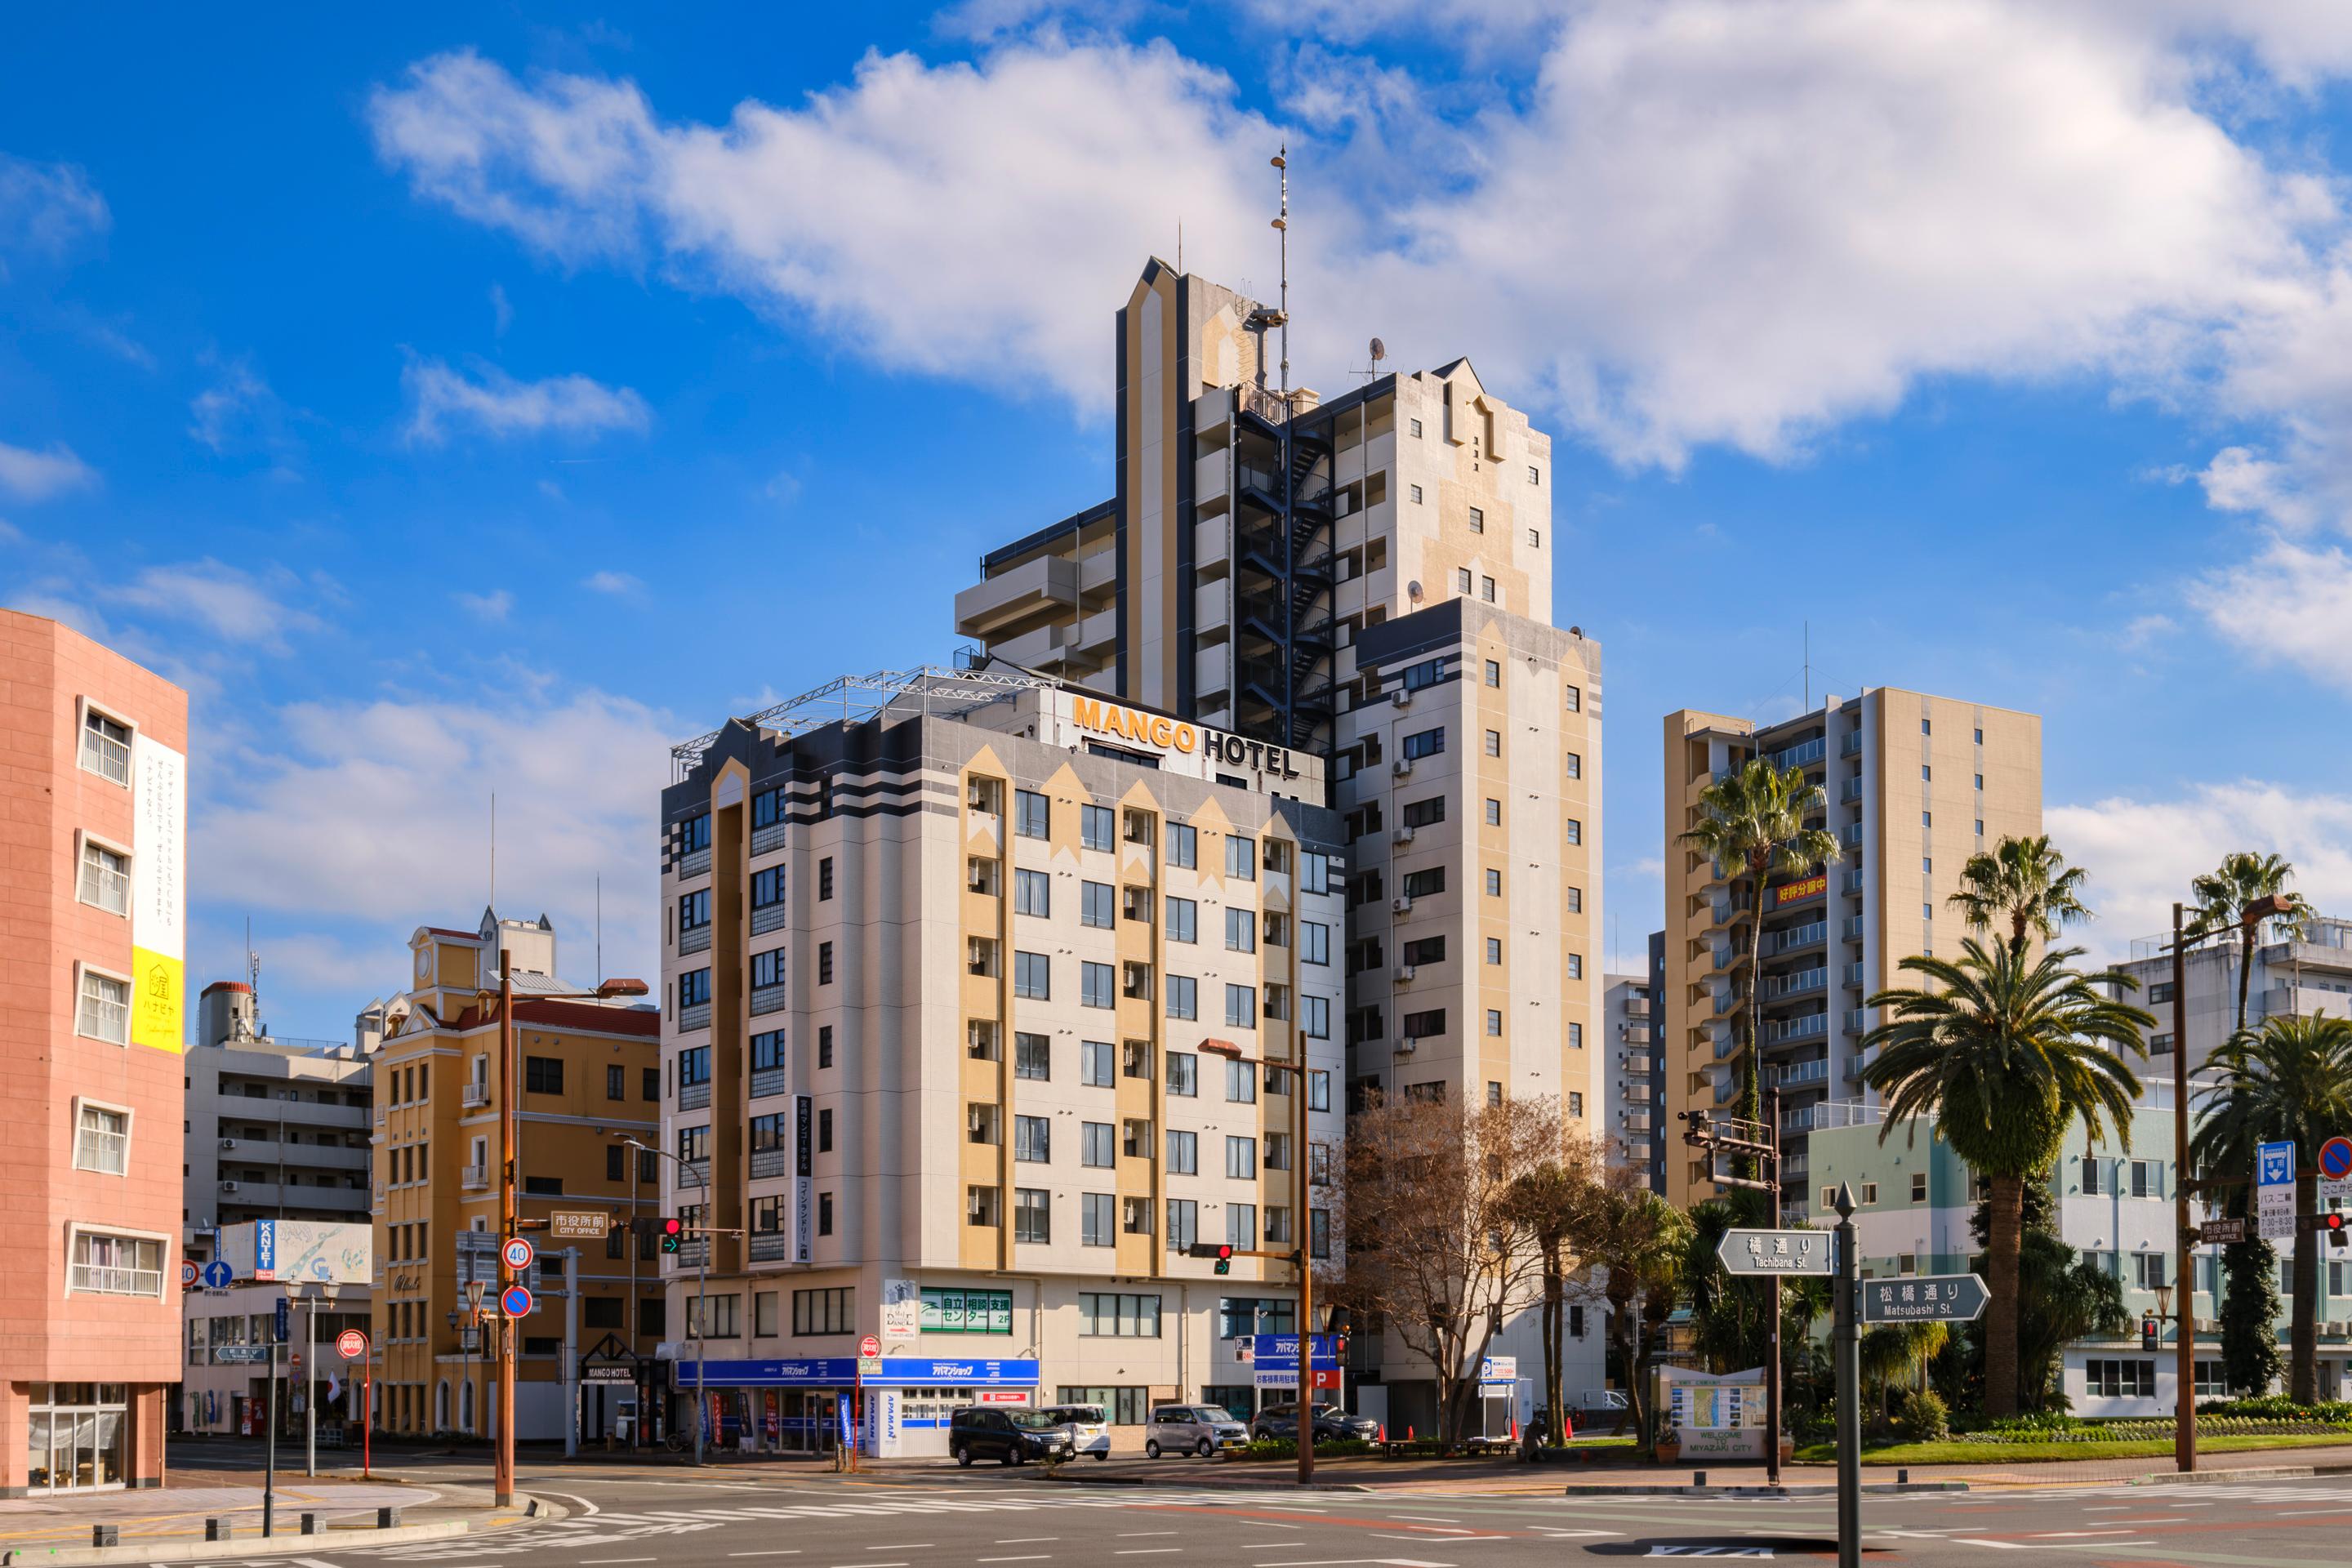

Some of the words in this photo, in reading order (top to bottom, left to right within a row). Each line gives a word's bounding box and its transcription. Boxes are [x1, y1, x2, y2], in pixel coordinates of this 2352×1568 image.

[1073, 696, 1196, 753] MANGO
[1204, 729, 1299, 778] HOTEL
[143, 1000, 175, 1016] ハナビヤ
[2267, 1159, 2284, 1169] 専用
[555, 1215, 604, 1227] 市役所前
[2203, 1222, 2240, 1234] 市役所前
[261, 1223, 271, 1267] KANTEI
[1748, 1236, 1811, 1254] 橘通り
[510, 1248, 526, 1261] 40
[1754, 1257, 1793, 1268] Tachibana
[1797, 1257, 1807, 1268] St.
[1880, 1283, 1958, 1302] 松橋通り
[943, 1298, 1010, 1311] 自立相談支援
[1884, 1304, 1935, 1316] Matsubashi
[1940, 1303, 1953, 1314] St.
[942, 1310, 987, 1322] センター
[589, 1368, 611, 1377] MANGO
[611, 1368, 630, 1377] HOTEL
[782, 1365, 809, 1375] アパマンショップ
[933, 1365, 973, 1376] アパマンショップ
[1316, 1372, 1326, 1386] P
